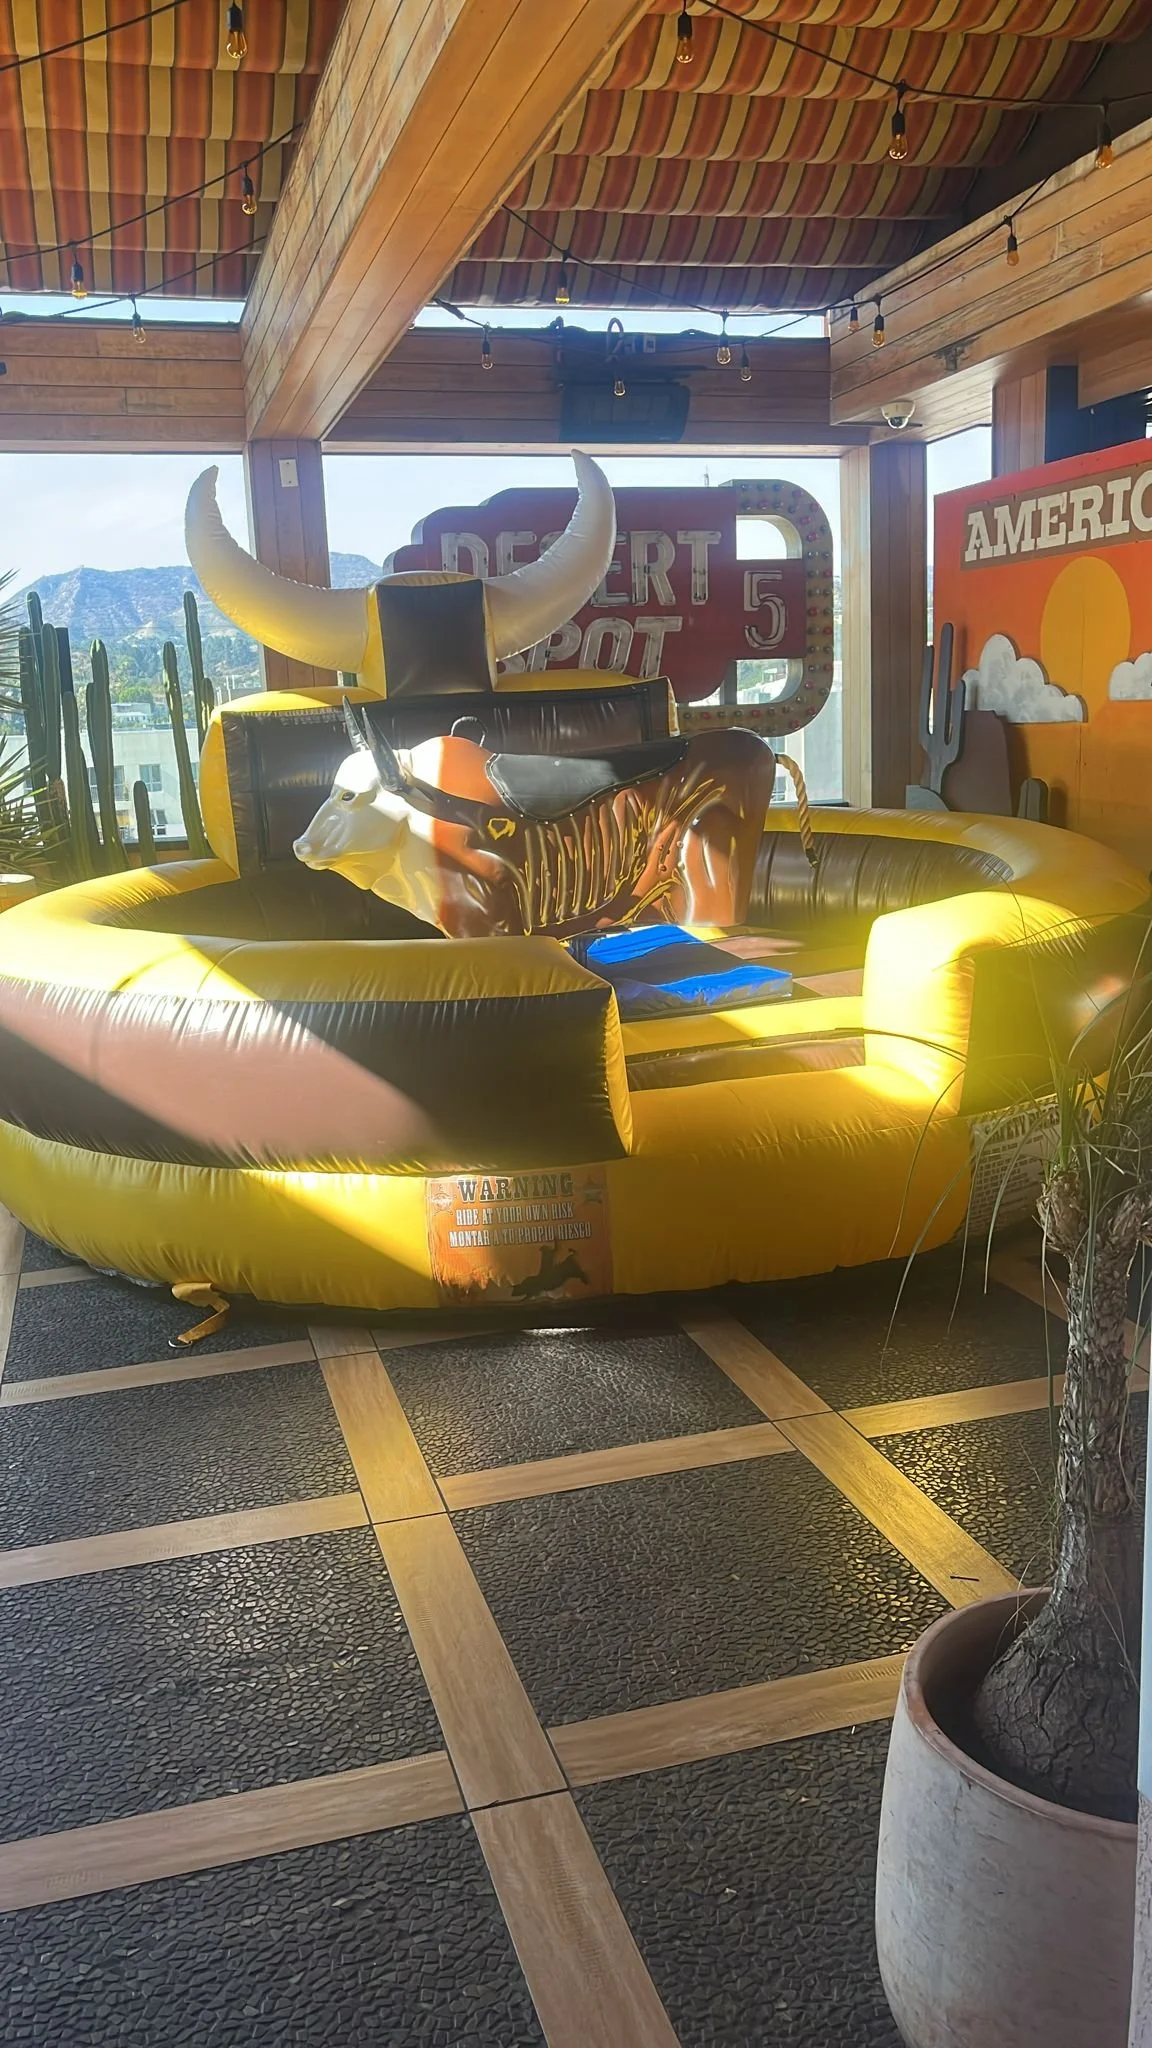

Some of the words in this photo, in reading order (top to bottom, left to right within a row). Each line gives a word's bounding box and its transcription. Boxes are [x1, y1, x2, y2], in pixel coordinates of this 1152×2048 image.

[441, 530, 722, 606] DEERT
[743, 570, 788, 650] 5
[457, 1172, 574, 1203] WARNING
[455, 1208, 479, 1226] RIDE
[482, 1207, 494, 1225] AT
[496, 1205, 523, 1224] YOUR
[525, 1204, 549, 1222] OWN
[552, 1202, 574, 1220] RISK
[449, 1230, 491, 1248] MONTAR
[493, 1229, 500, 1246] A
